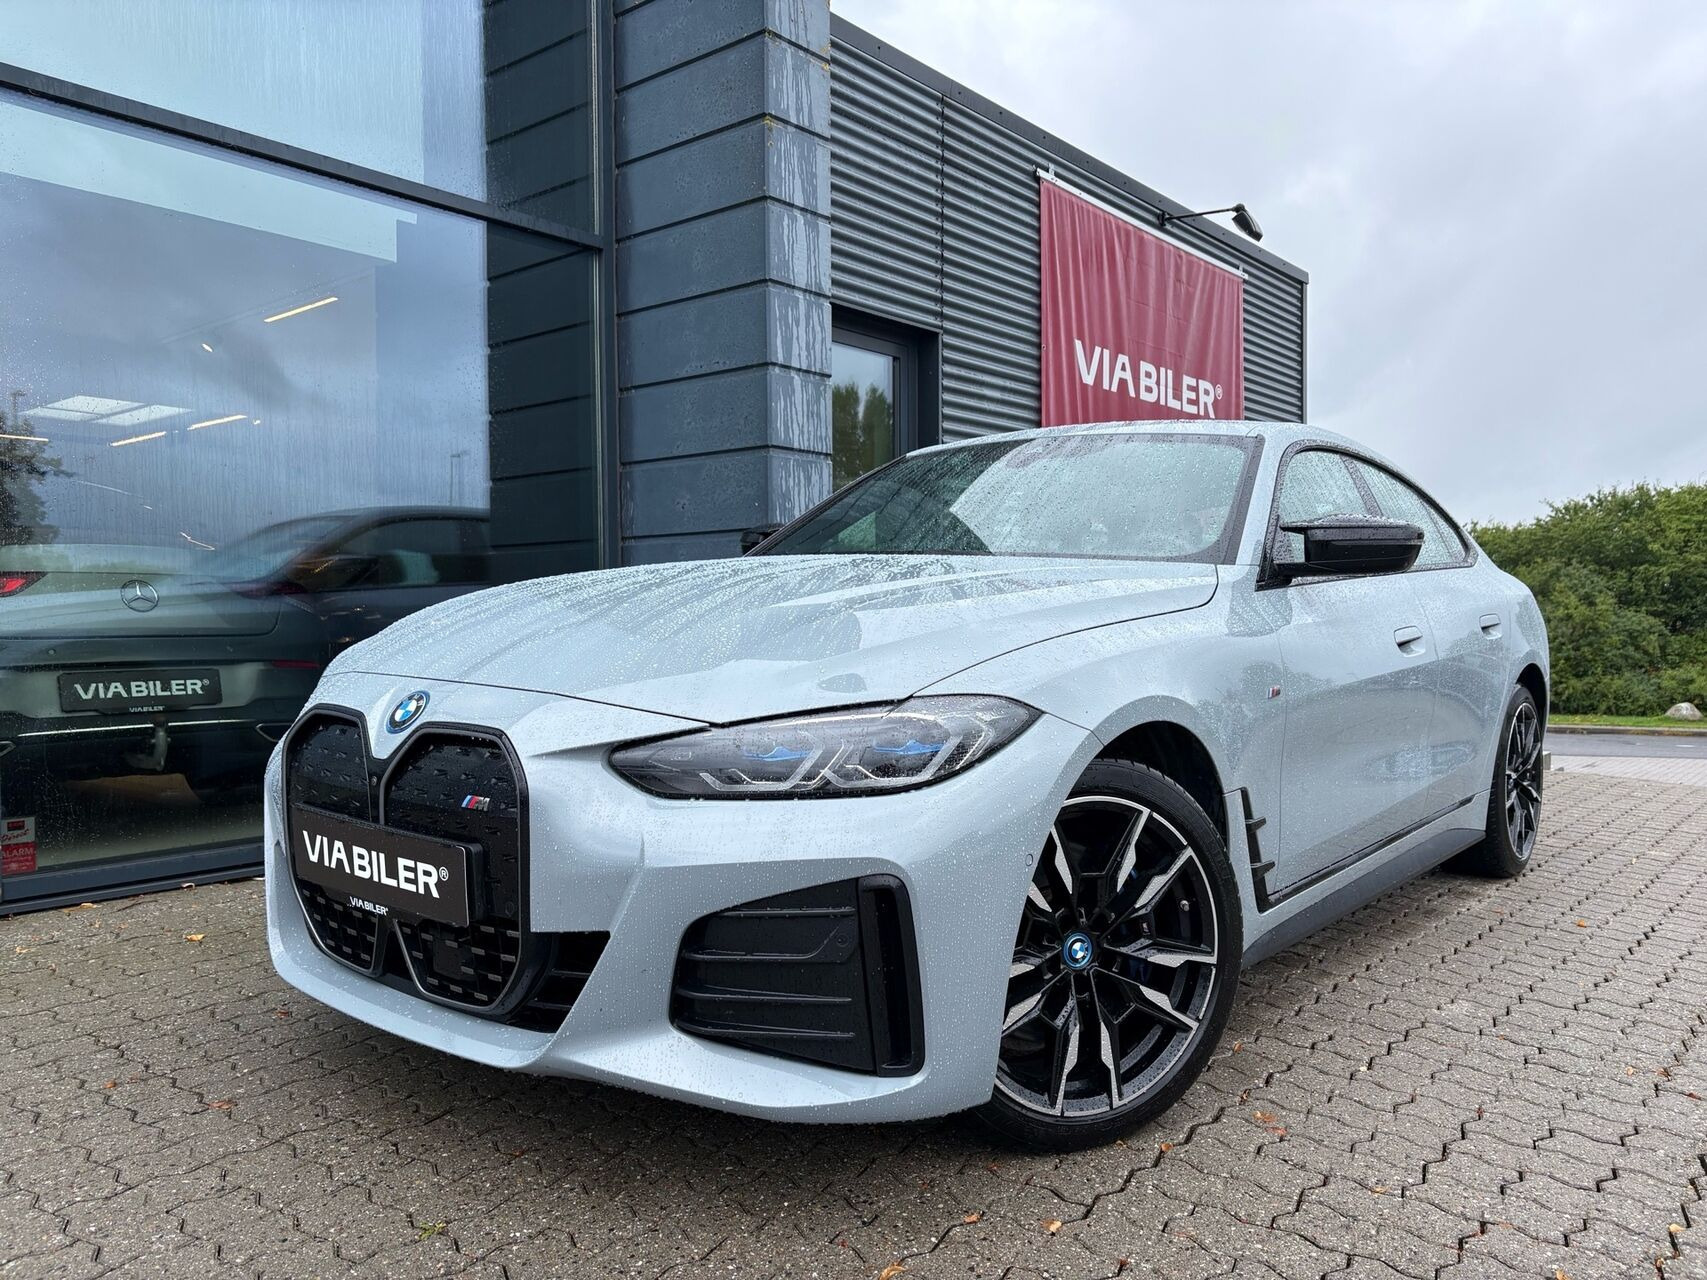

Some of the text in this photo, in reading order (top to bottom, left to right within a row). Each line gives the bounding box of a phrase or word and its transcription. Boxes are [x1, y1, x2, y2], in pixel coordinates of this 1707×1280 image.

[1074, 338, 1136, 398] VIA
[74, 682, 128, 700] VIA
[302, 830, 351, 874] VIA
